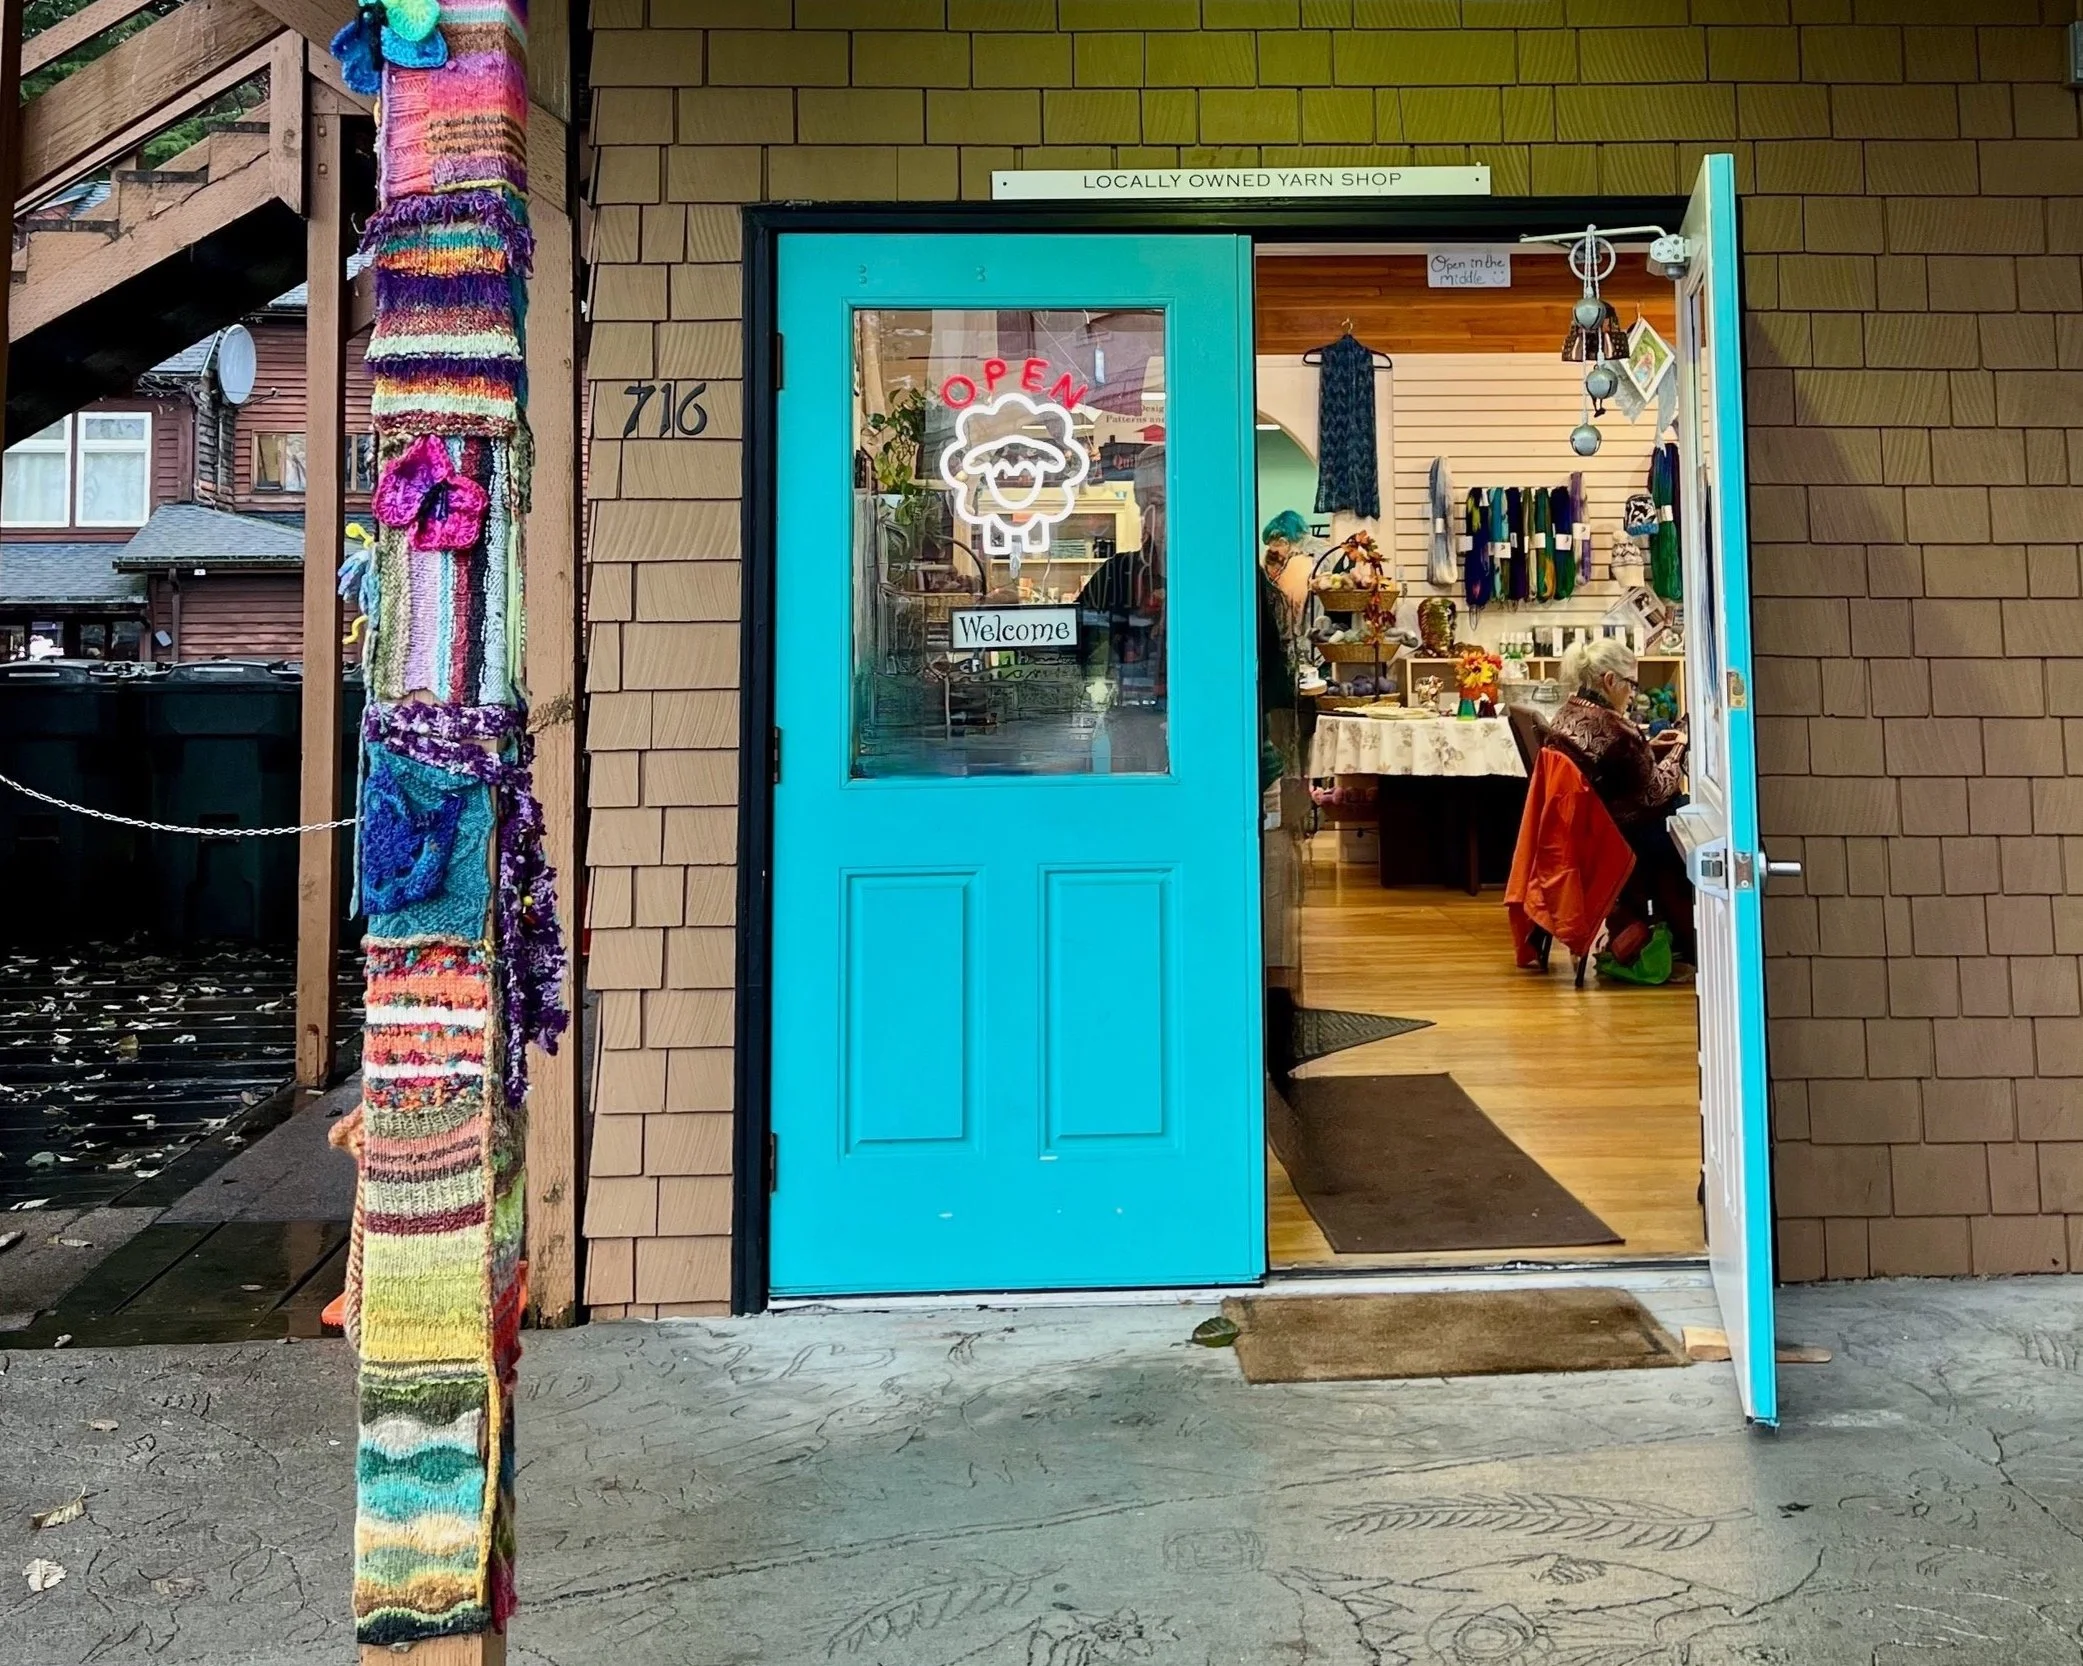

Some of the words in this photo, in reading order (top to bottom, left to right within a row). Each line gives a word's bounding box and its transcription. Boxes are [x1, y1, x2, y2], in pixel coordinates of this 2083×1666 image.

[1083, 174, 1182, 189] LOCALLY
[1188, 173, 1271, 188] OWNED
[1277, 173, 1333, 187] YARN
[1341, 172, 1402, 187] SHOP
[1431, 255, 1466, 275] Open
[1470, 258, 1483, 269] in
[1485, 254, 1505, 269] the
[940, 357, 1089, 410] OPEN
[623, 382, 708, 439] 716
[1106, 414, 1147, 423] Patterns
[958, 614, 1070, 643] Welcome
